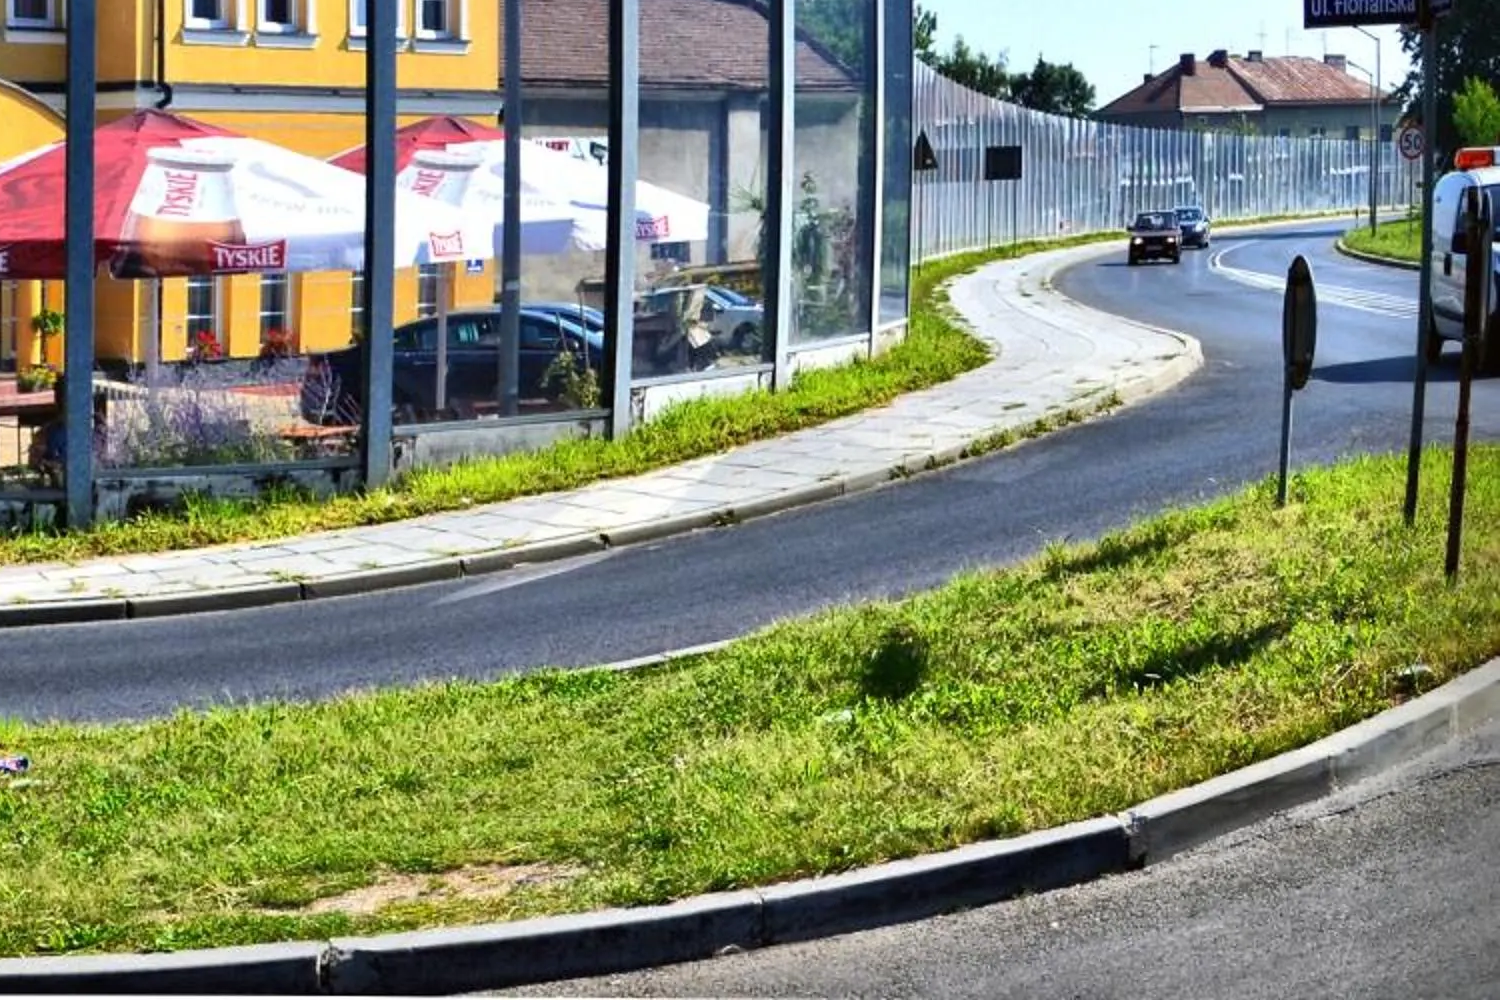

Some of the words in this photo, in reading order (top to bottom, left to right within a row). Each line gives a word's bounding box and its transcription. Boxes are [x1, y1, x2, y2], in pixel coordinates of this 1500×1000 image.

[1404, 134, 1421, 150] 50
[156, 170, 198, 217] TYSKIE
[212, 245, 280, 269] TYSKIE
